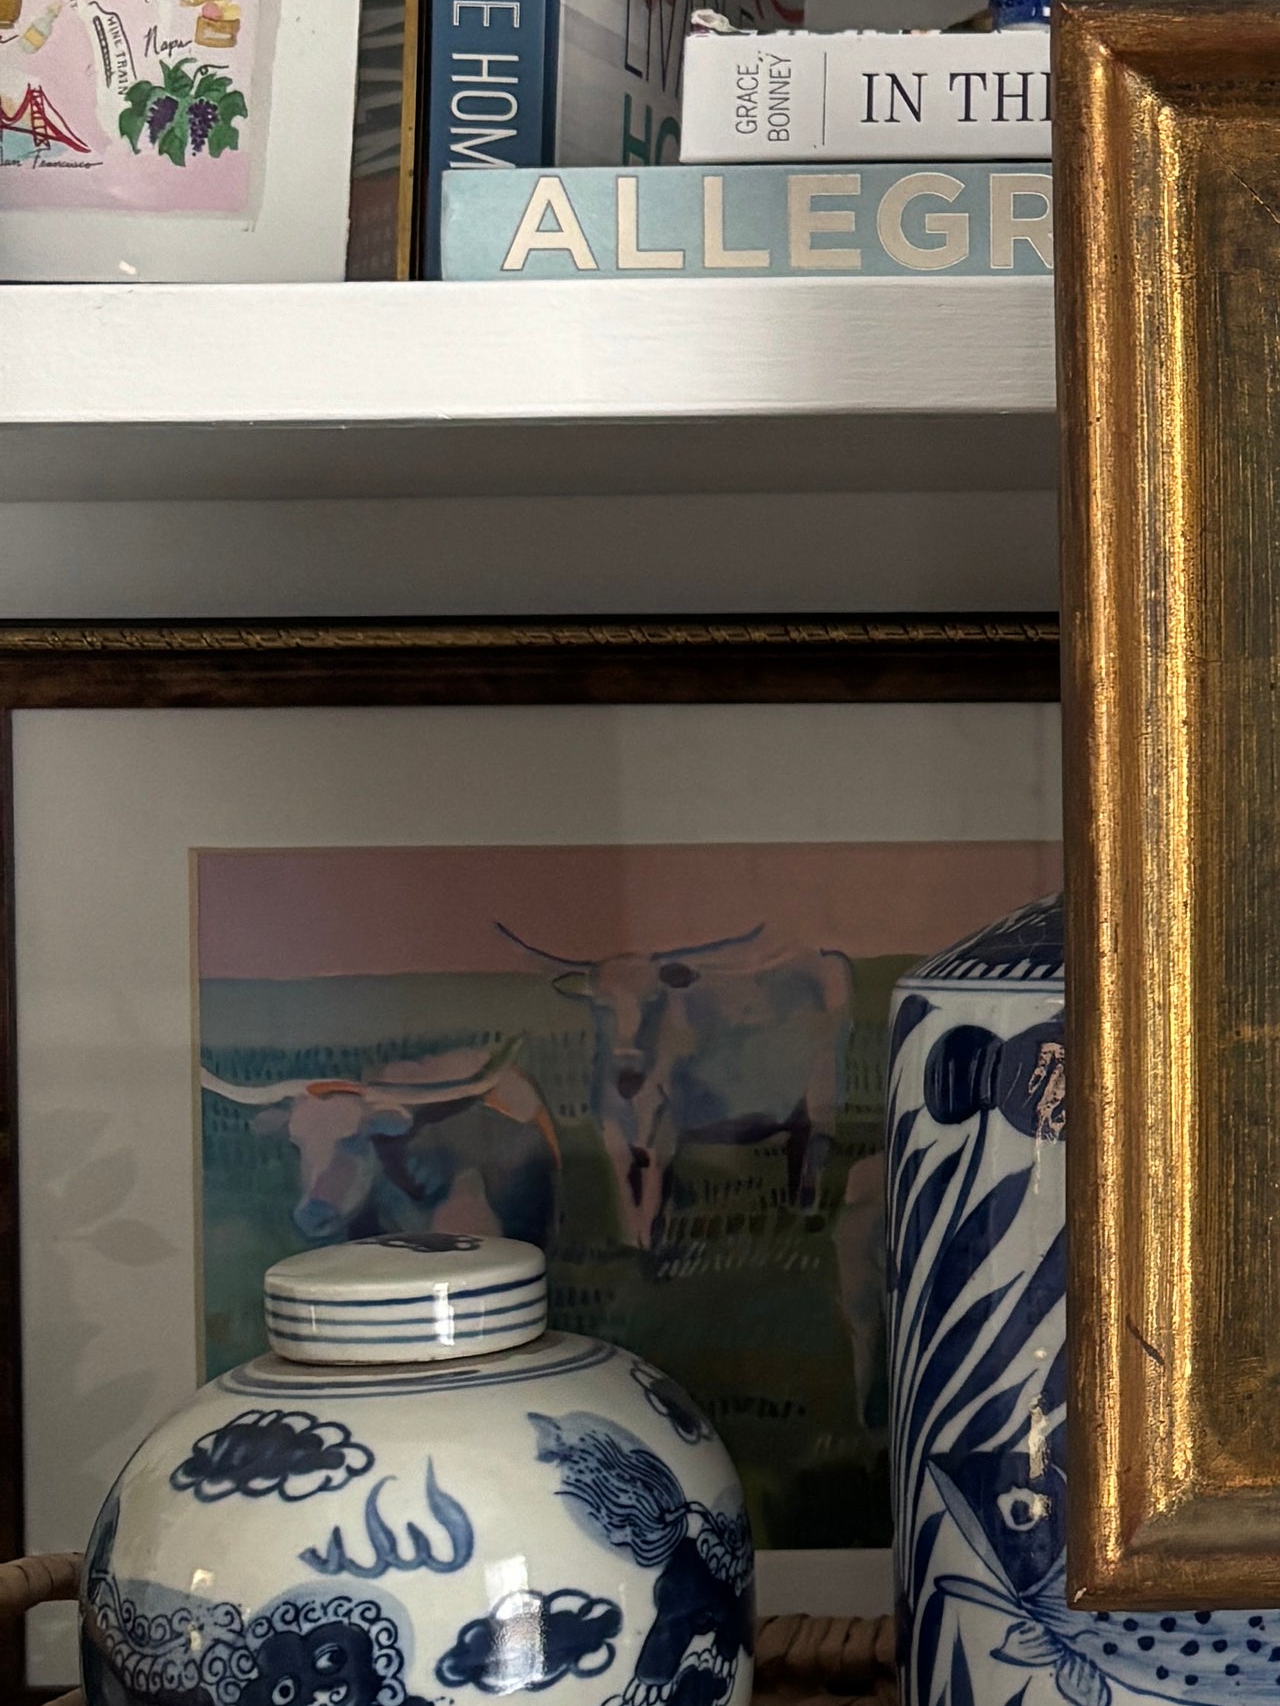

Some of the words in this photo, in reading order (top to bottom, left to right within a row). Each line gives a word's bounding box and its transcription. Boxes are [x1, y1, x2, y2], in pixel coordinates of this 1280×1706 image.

[735, 64, 760, 135] GRACE
[767, 54, 792, 142] BONNEY
[860, 72, 928, 124] IN
[500, 172, 1054, 271] ALLEGR
